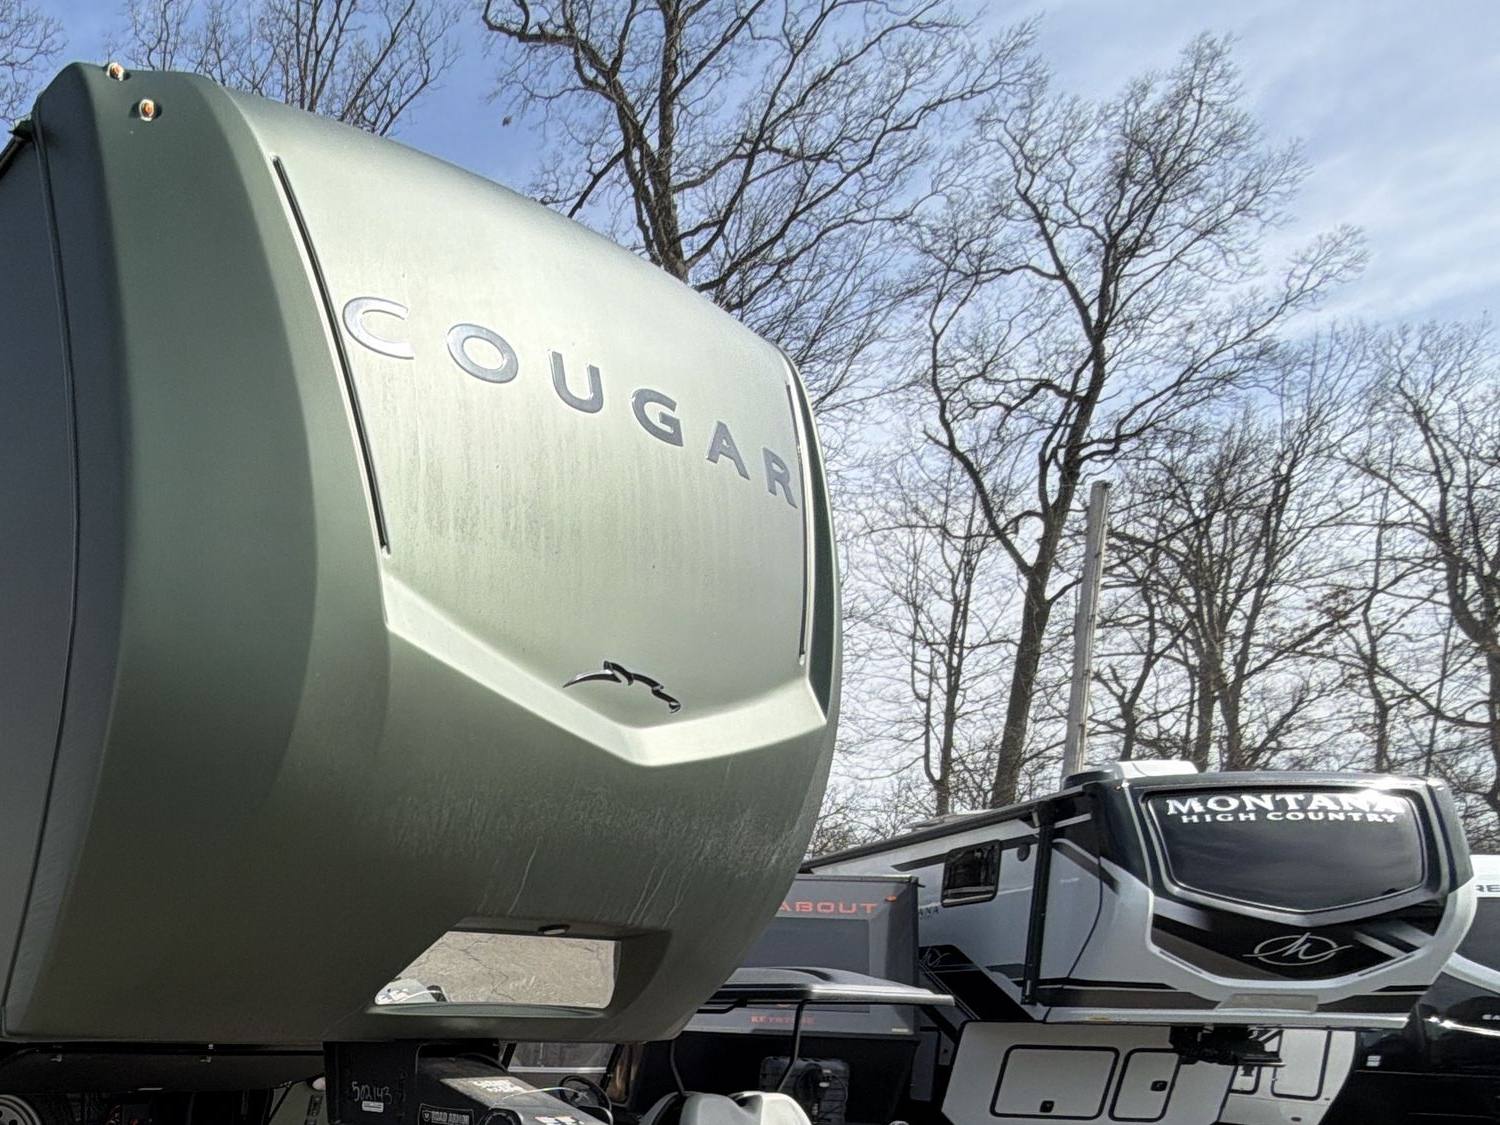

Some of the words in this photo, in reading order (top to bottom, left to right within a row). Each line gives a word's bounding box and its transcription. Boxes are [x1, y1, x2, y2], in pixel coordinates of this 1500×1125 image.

[342, 296, 798, 509] COUGAR
[1166, 794, 1405, 815] MONTANA
[1181, 812, 1257, 824] HIGH
[1266, 811, 1397, 823] COUNTRY
